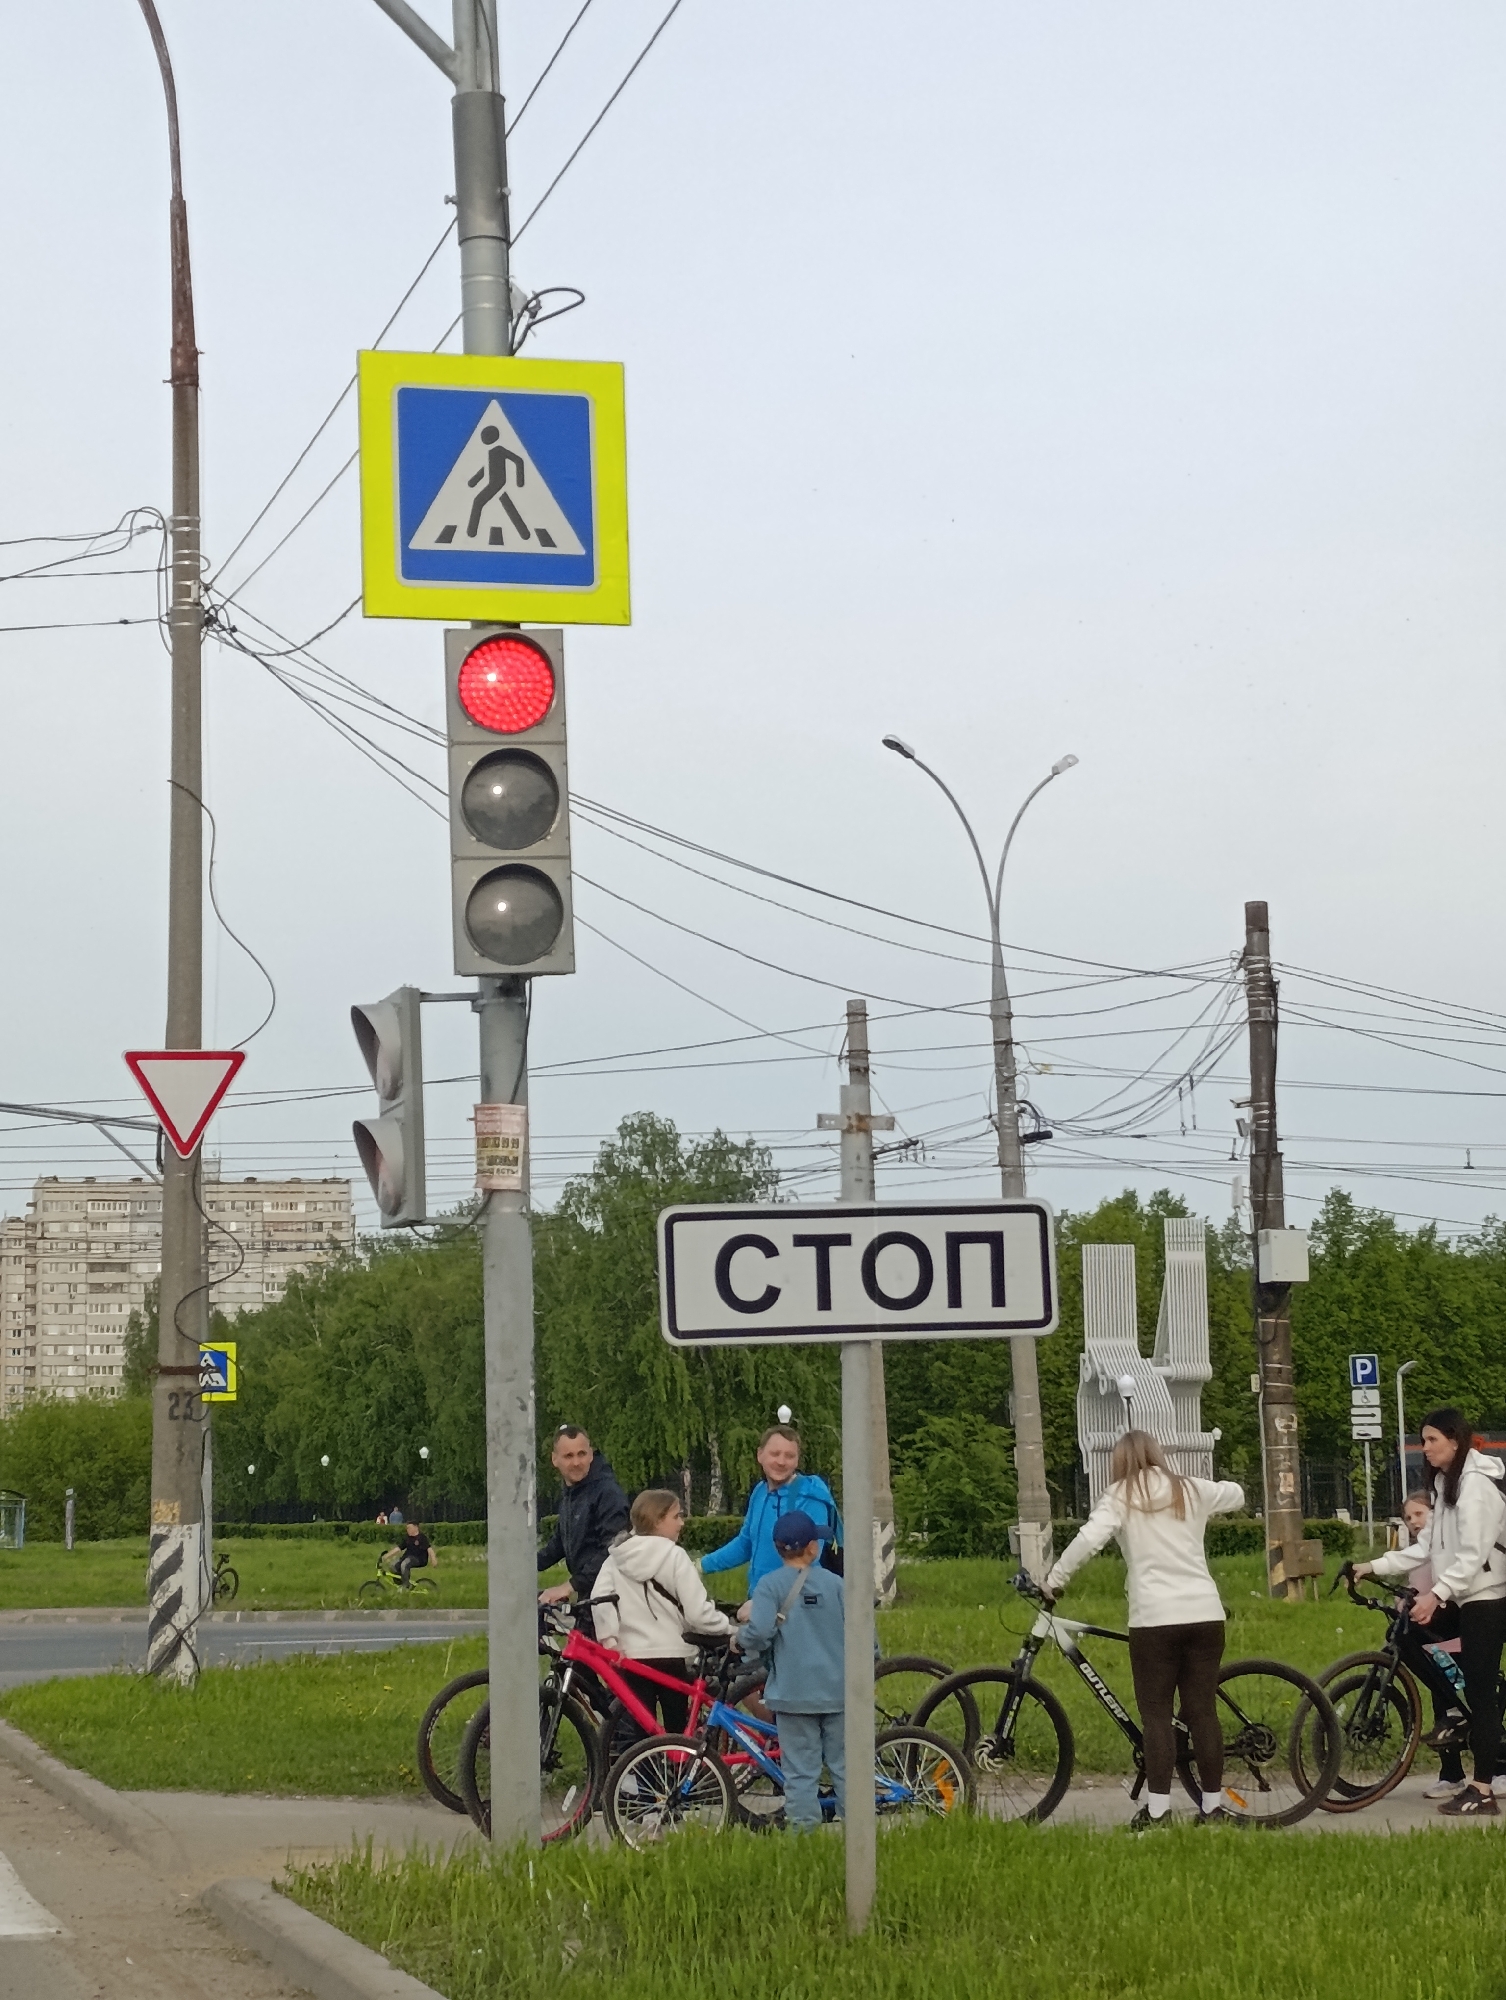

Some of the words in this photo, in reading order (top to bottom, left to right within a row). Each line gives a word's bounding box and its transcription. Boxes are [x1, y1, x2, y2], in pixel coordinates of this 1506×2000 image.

[714, 1230, 1006, 1314] СТОП
[1355, 1358, 1373, 1383] P
[168, 1391, 194, 1420] 23
